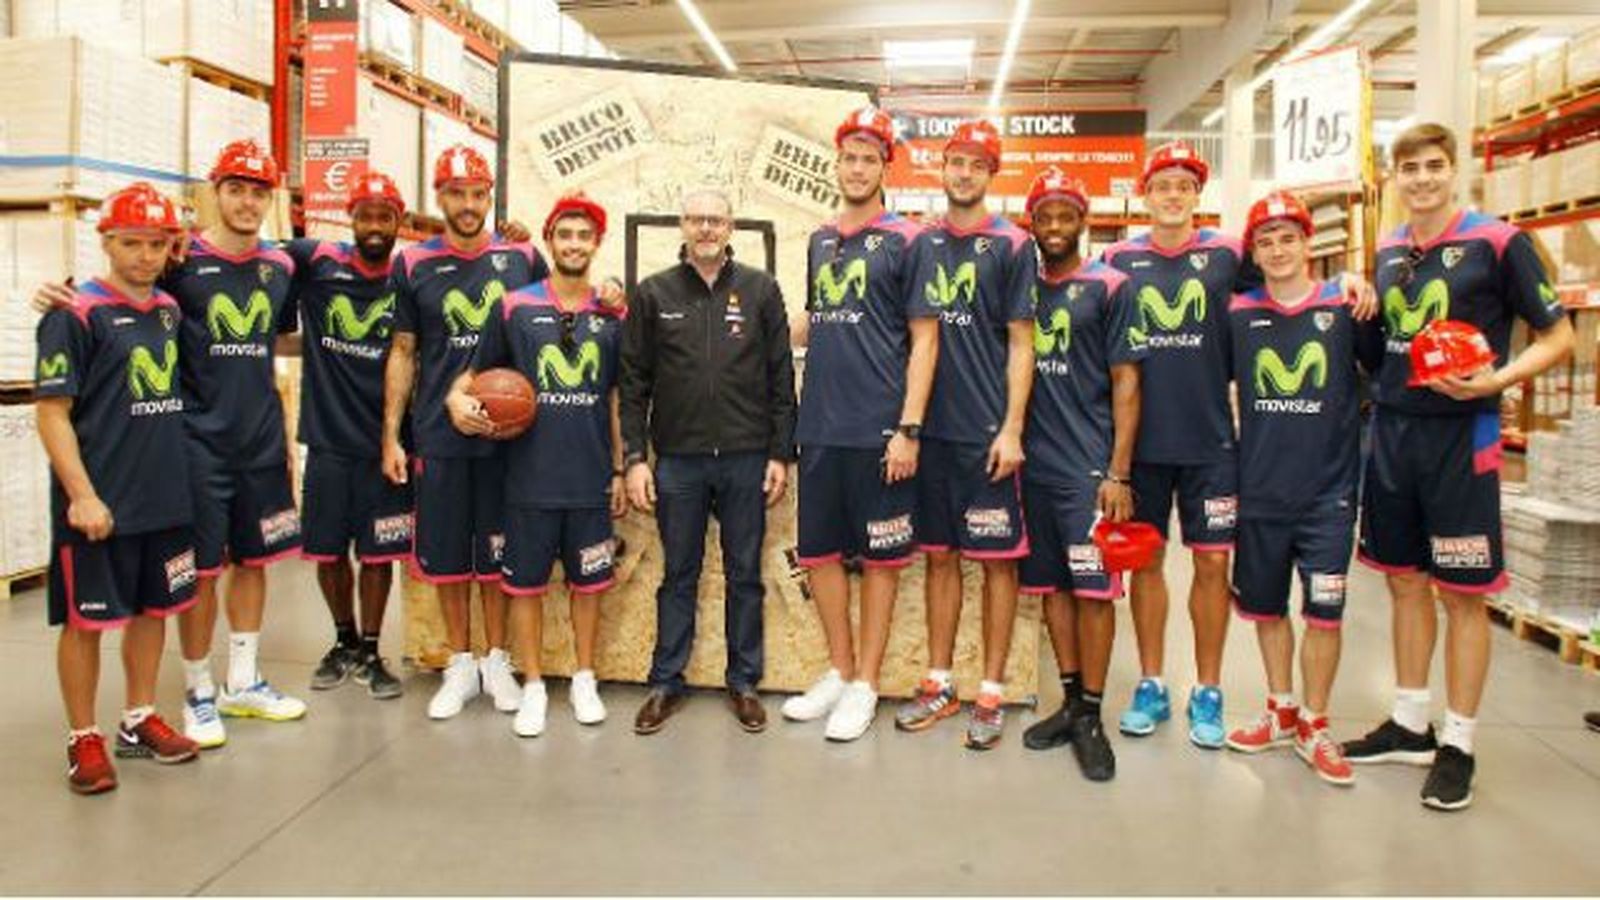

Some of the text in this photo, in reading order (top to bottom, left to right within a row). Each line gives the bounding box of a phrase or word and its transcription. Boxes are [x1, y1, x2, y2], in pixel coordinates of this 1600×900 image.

[539, 100, 626, 152] BRICO
[917, 115, 960, 136] 100
[1009, 115, 1076, 136] STOCK
[554, 123, 640, 177] DEPOT
[773, 138, 838, 180] BRIC
[131, 398, 183, 416] movista
[537, 391, 599, 406] movistar
[1254, 398, 1322, 414] movistar
